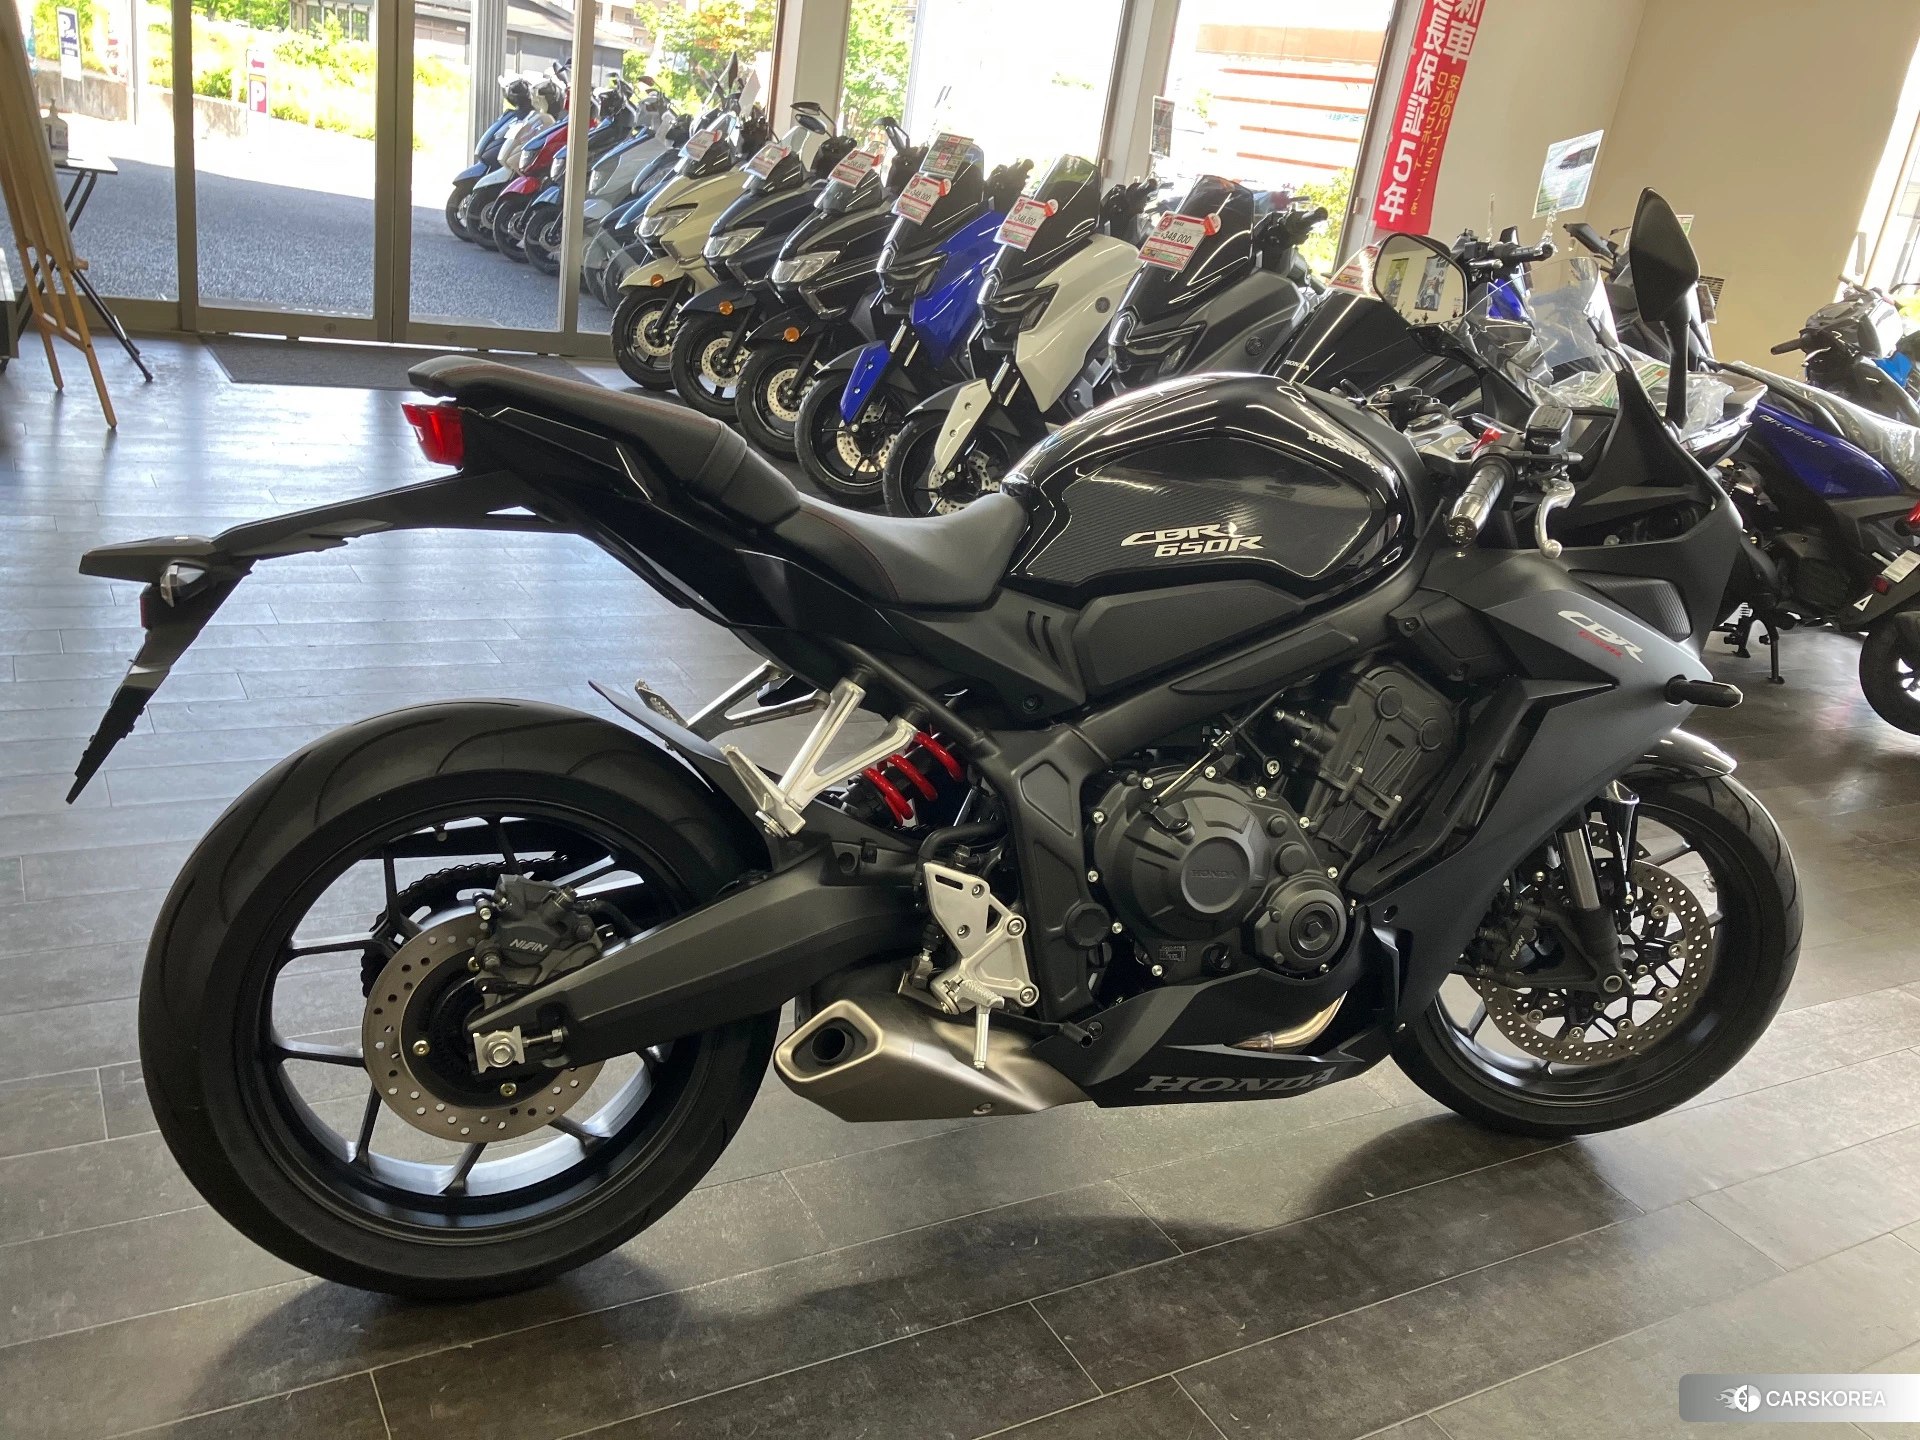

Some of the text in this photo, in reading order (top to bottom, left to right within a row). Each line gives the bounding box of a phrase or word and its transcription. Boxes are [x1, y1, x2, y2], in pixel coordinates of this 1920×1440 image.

[250, 80, 266, 111] P
[1378, 0, 1455, 223] 長保証5年
[1120, 523, 1246, 547] CBR
[1154, 535, 1265, 558] 650R
[1557, 610, 1644, 664] CBR
[1190, 869, 1236, 879] HONDA
[1133, 1066, 1338, 1092] HONDA
